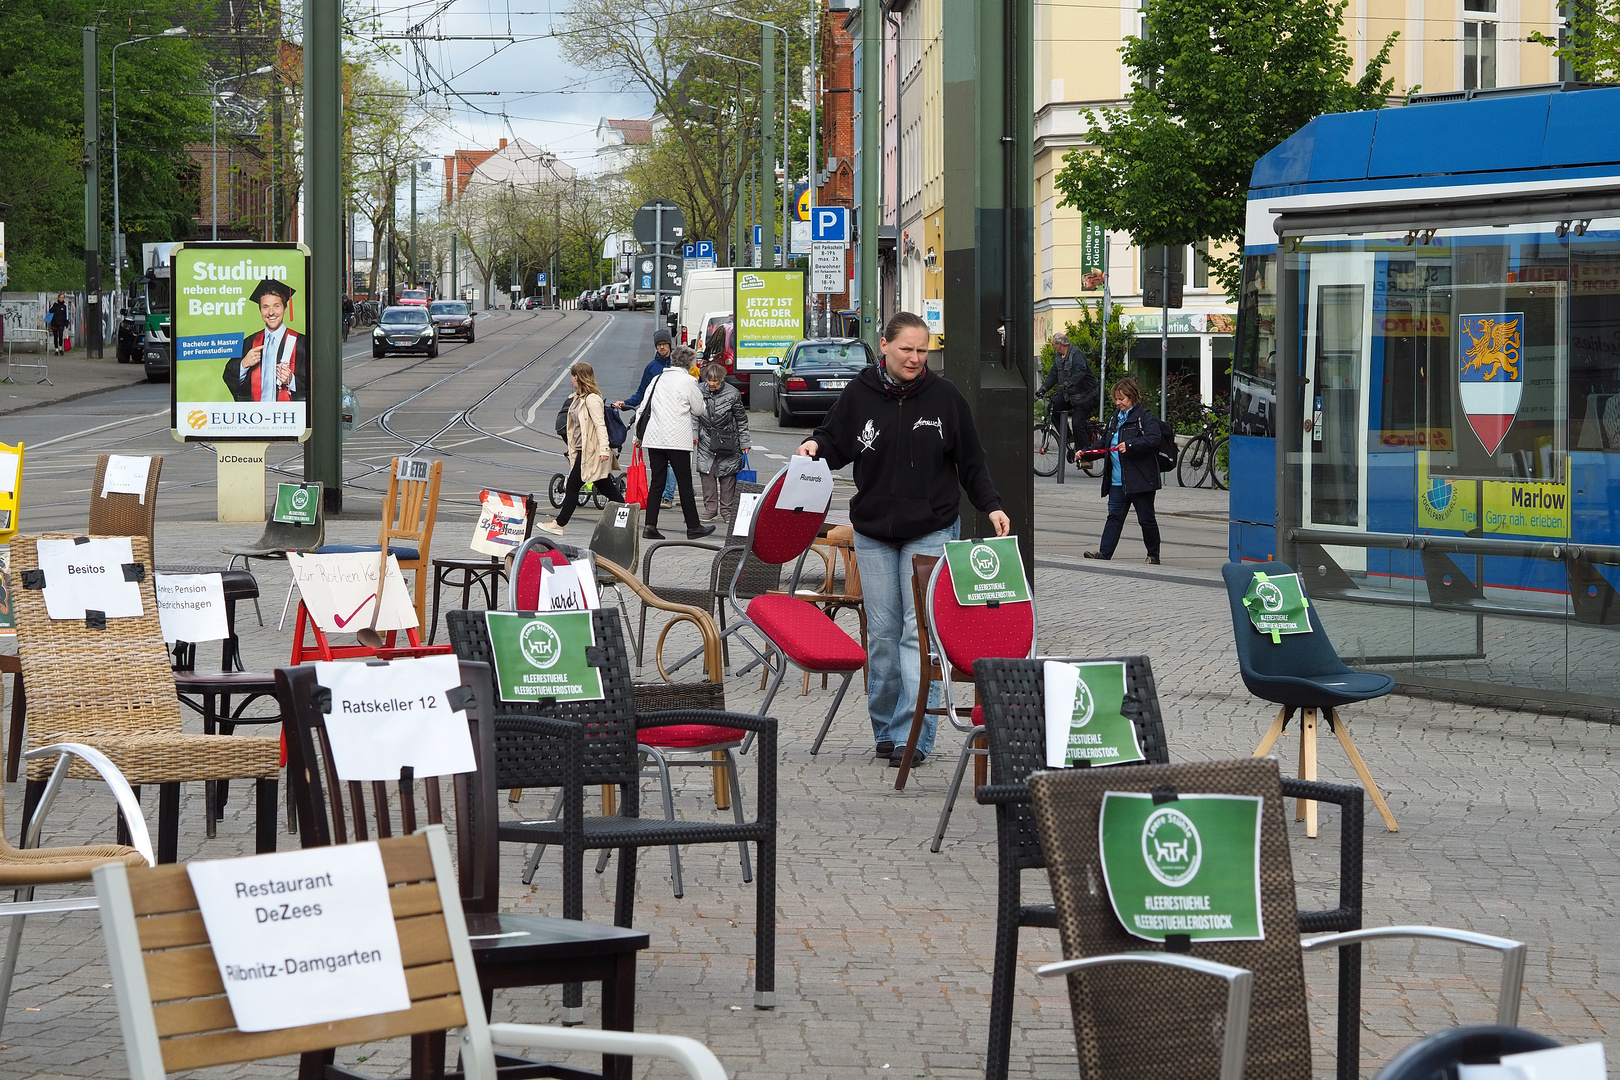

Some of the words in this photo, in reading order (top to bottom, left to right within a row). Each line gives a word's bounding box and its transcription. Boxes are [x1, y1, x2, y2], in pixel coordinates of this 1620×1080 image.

[819, 211, 837, 237] P
[193, 259, 287, 281] Studium
[183, 285, 217, 294] neben
[219, 285, 242, 294] dem
[189, 297, 246, 315] Beruf
[746, 298, 775, 308] JETZT
[777, 298, 793, 306] IST
[748, 309, 769, 317] TAG
[771, 309, 791, 317] DER
[740, 319, 800, 327] NACHBARN
[1158, 321, 1189, 332] Kntine
[183, 340, 209, 348] Bachelor
[183, 348, 194, 356] per
[194, 347, 233, 355] Fernstudium
[211, 412, 296, 424] EURO-FH
[219, 455, 263, 463] JCDecaux
[1421, 493, 1446, 521] VOGELPARK
[1444, 487, 1459, 519] MARLOW
[1512, 487, 1565, 510] Marlow
[1486, 510, 1507, 525] Ganz
[1509, 512, 1528, 526] nah.
[1530, 514, 1565, 529] erleben.
[68, 564, 105, 575] Besitos
[297, 565, 314, 582] Zur
[315, 563, 360, 583] Rothen
[174, 584, 207, 594] Pension
[158, 600, 212, 611] Diedrichshagen
[523, 625, 536, 640] Leere
[536, 624, 555, 639] Stühle
[523, 673, 568, 684] #LEERESTUEHLE
[514, 684, 584, 695] #LEERESTUEHLEROSTOCK
[342, 698, 414, 714] Ratskeller
[418, 695, 437, 710] 12
[1068, 734, 1103, 745] ERESTUEHLE
[1065, 746, 1120, 759] STUEHLEROSTOCK
[1147, 816, 1167, 838] Leere
[1167, 813, 1193, 839] Stühle
[234, 871, 334, 899] Restaurant
[1144, 895, 1211, 911] #LEERESTUEHLE
[256, 902, 323, 925] DeZees
[1133, 914, 1234, 930] #LEERESTUEHLEROSTOCK
[226, 947, 383, 982] Ribnitz-Damgarten
